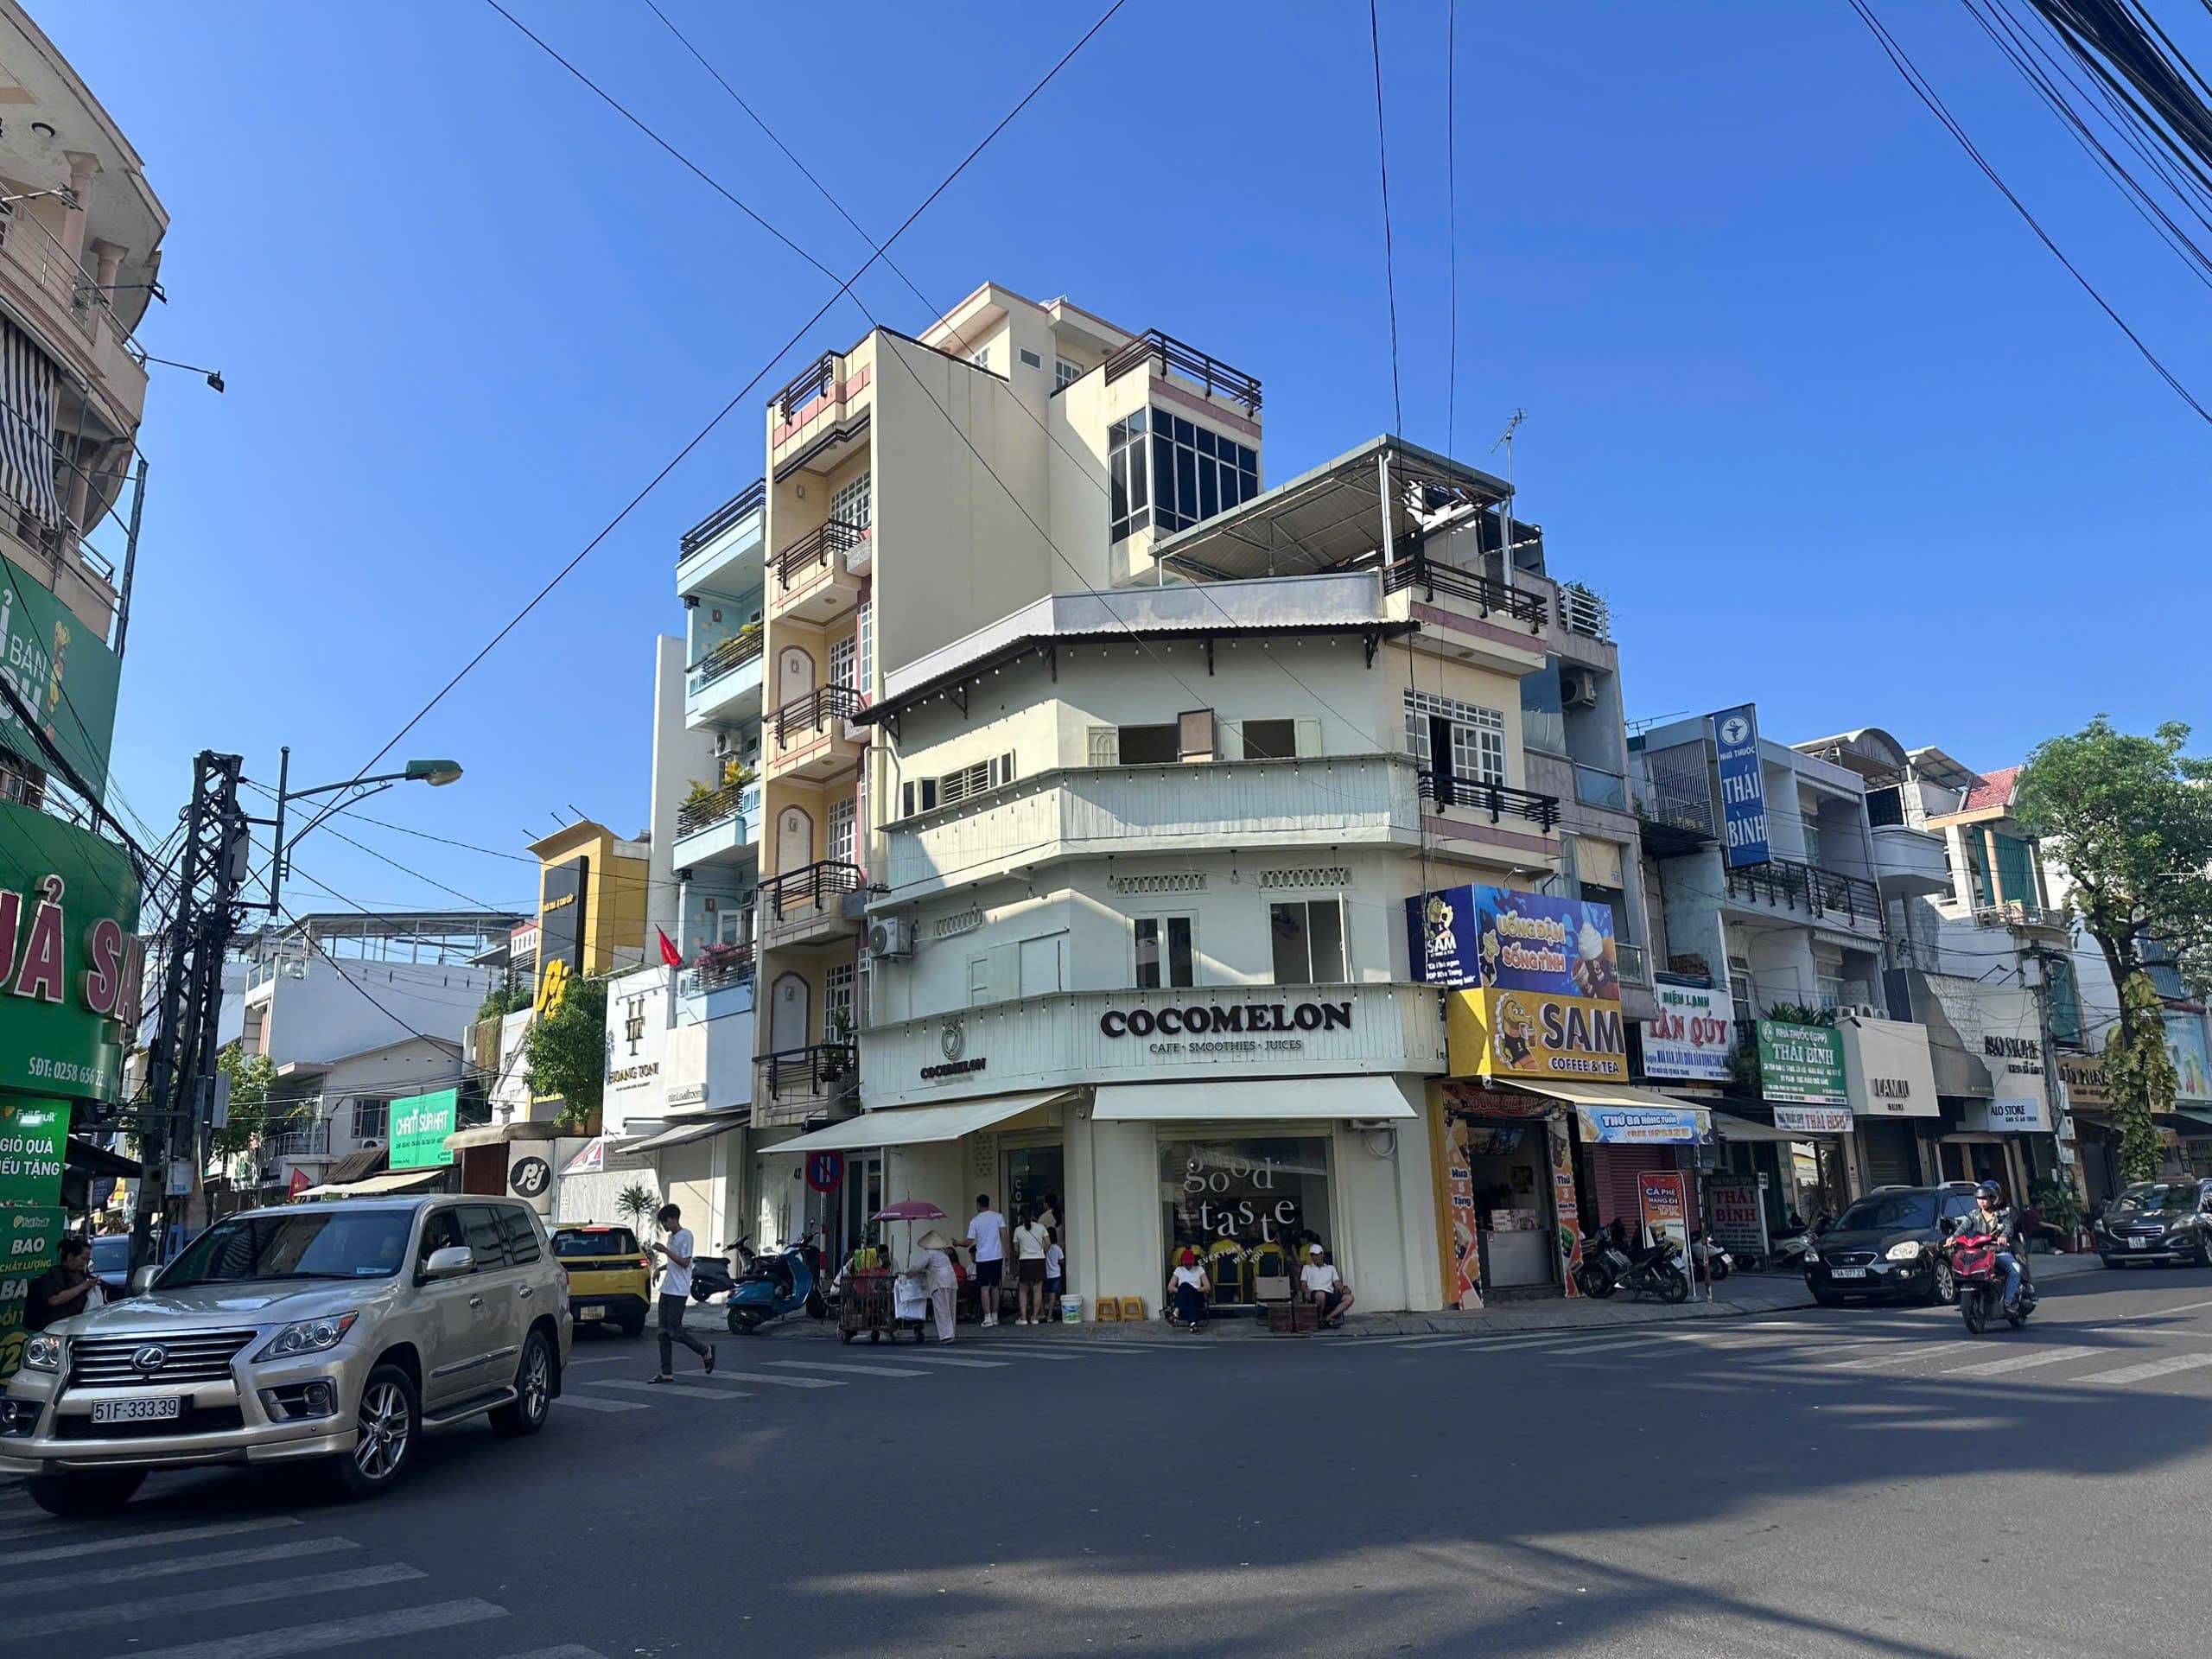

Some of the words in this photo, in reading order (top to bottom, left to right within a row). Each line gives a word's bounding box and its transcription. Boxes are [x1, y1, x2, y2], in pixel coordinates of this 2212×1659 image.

[10, 633, 47, 683] BÁN
[1723, 765, 1760, 804] THÁI
[1728, 810, 1767, 848] BÌNH
[1497, 910, 1534, 939] UỐNG
[1502, 942, 1538, 970] SỐNG
[1538, 947, 1566, 972] TÌNH
[1100, 1002, 1351, 1038] COCOMELON
[1540, 1002, 1626, 1055] SAM
[1649, 1007, 1685, 1040] TÂN
[1149, 1043, 1179, 1054] CAFE
[1189, 1041, 1255, 1053] SMOOTHIES
[1265, 1039, 1302, 1052] JUICES
[1771, 1040, 1804, 1062] THÁI
[1805, 1042, 1834, 1065] BÌNH
[29, 1057, 52, 1077] SĐT:
[54, 1062, 78, 1081] 0258
[79, 1066, 94, 1084] 656
[920, 1057, 988, 1080] COCOMELON
[1548, 1057, 1589, 1072] COFFEE
[1590, 1059, 1599, 1072] &
[1599, 1060, 1620, 1073] TEA
[1601, 1112, 1626, 1128] THỨ
[1626, 1114, 1641, 1127] BA
[1805, 1111, 1825, 1129] THÁI
[1826, 1112, 1847, 1129] BÌNH
[1991, 1106, 2004, 1116] ALO
[2005, 1105, 2025, 1116] STORE
[1627, 1128, 1646, 1138] FREE
[0, 1135, 23, 1153] GIỎ
[23, 1158, 60, 1179] TẶNG
[1183, 1157, 1274, 1192] good
[1452, 1169, 1469, 1179] Mua
[1453, 1196, 1471, 1207] Tặng
[1714, 1186, 1755, 1204] THÁI
[1200, 1200, 1297, 1243] taste
[1714, 1205, 1758, 1222] BÌNH
[11, 1236, 45, 1255] BAO
[1198, 1243, 1242, 1266] EVERYDAY
[1232, 1247, 1254, 1264] WITH
[1249, 1249, 1265, 1264] YOU
[95, 1400, 176, 1420] 51F-333.39
